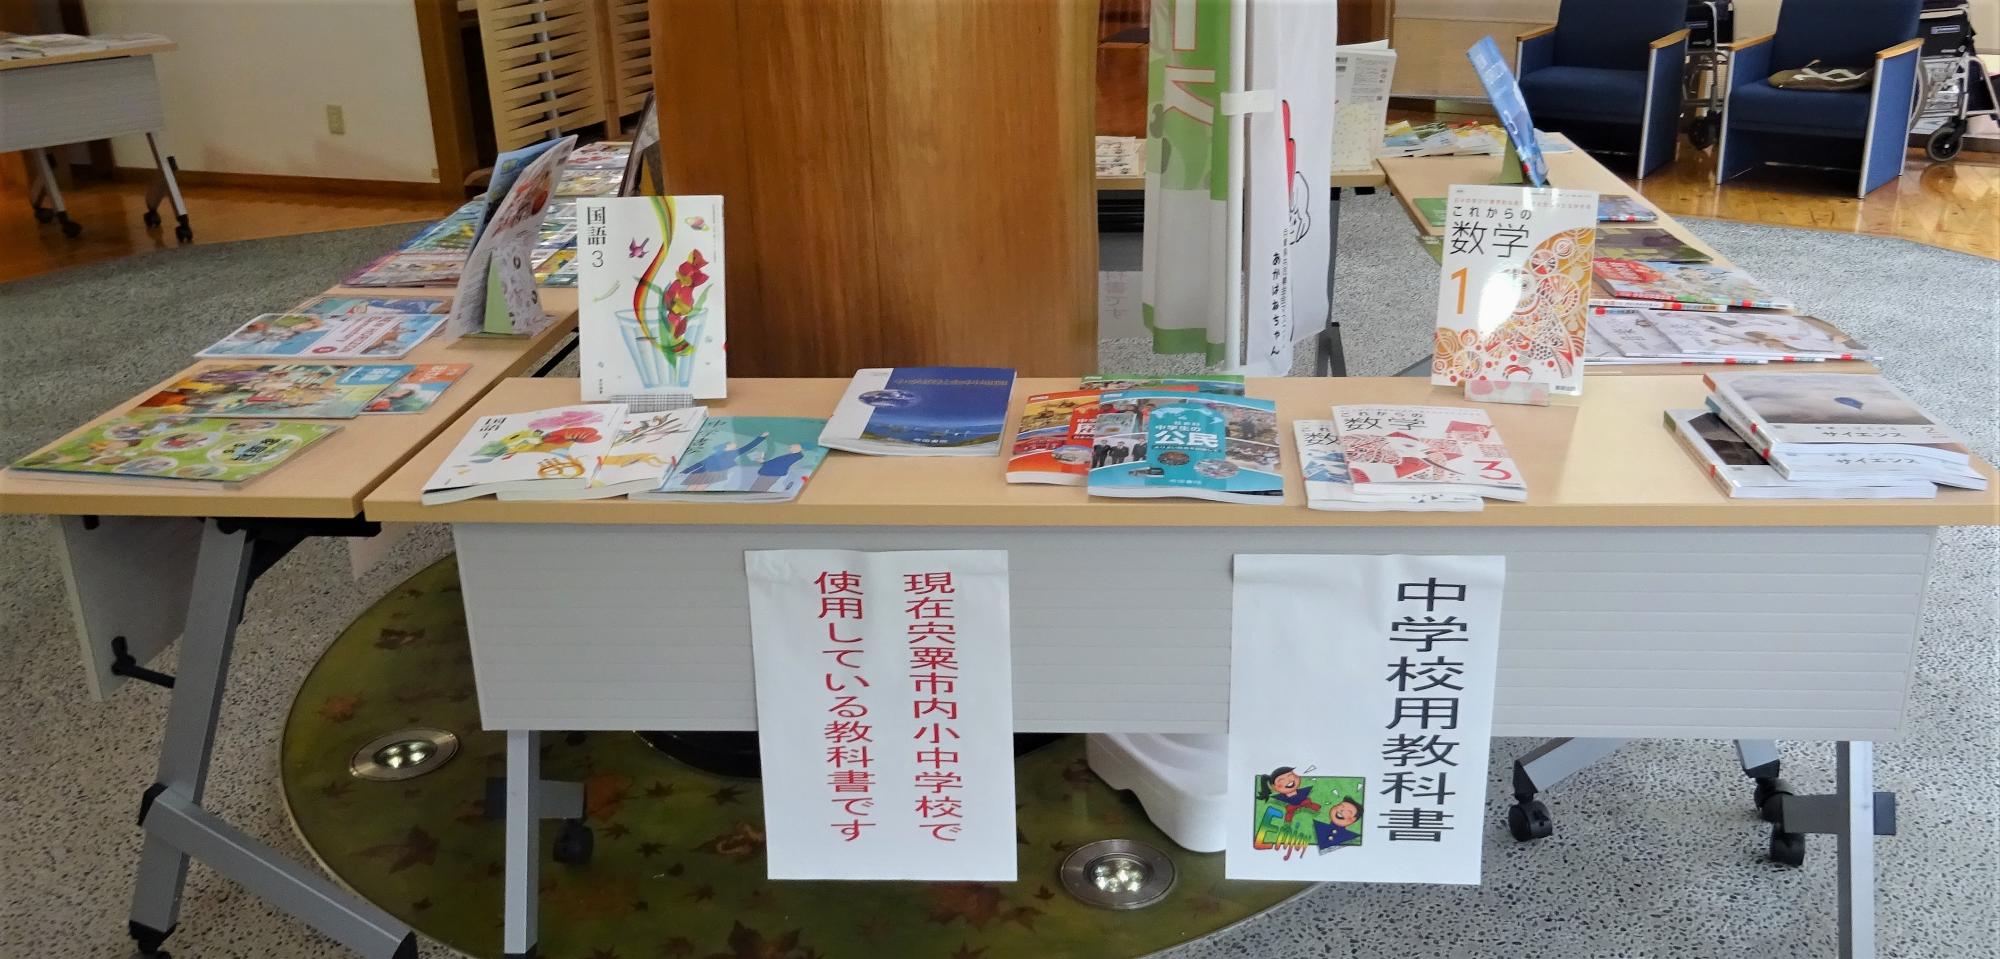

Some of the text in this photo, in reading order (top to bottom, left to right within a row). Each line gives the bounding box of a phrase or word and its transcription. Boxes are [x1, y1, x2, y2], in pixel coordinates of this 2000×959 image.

[1452, 206, 1532, 221] これからの
[586, 205, 607, 268] 国語 3
[1449, 221, 1530, 258] 数学
[1450, 267, 1469, 315] 1
[1343, 416, 1428, 432] 数学
[1821, 430, 1908, 438] サイエンス
[1153, 429, 1220, 449] 公民
[1303, 431, 1339, 446] 数
[1473, 460, 1513, 481] 3
[1835, 457, 1922, 466] サイエンス
[813, 570, 877, 842] 使用している教科書です
[902, 570, 964, 842] 現在宍粟市内小中学校で
[1377, 577, 1470, 843] 中学校用教科書
